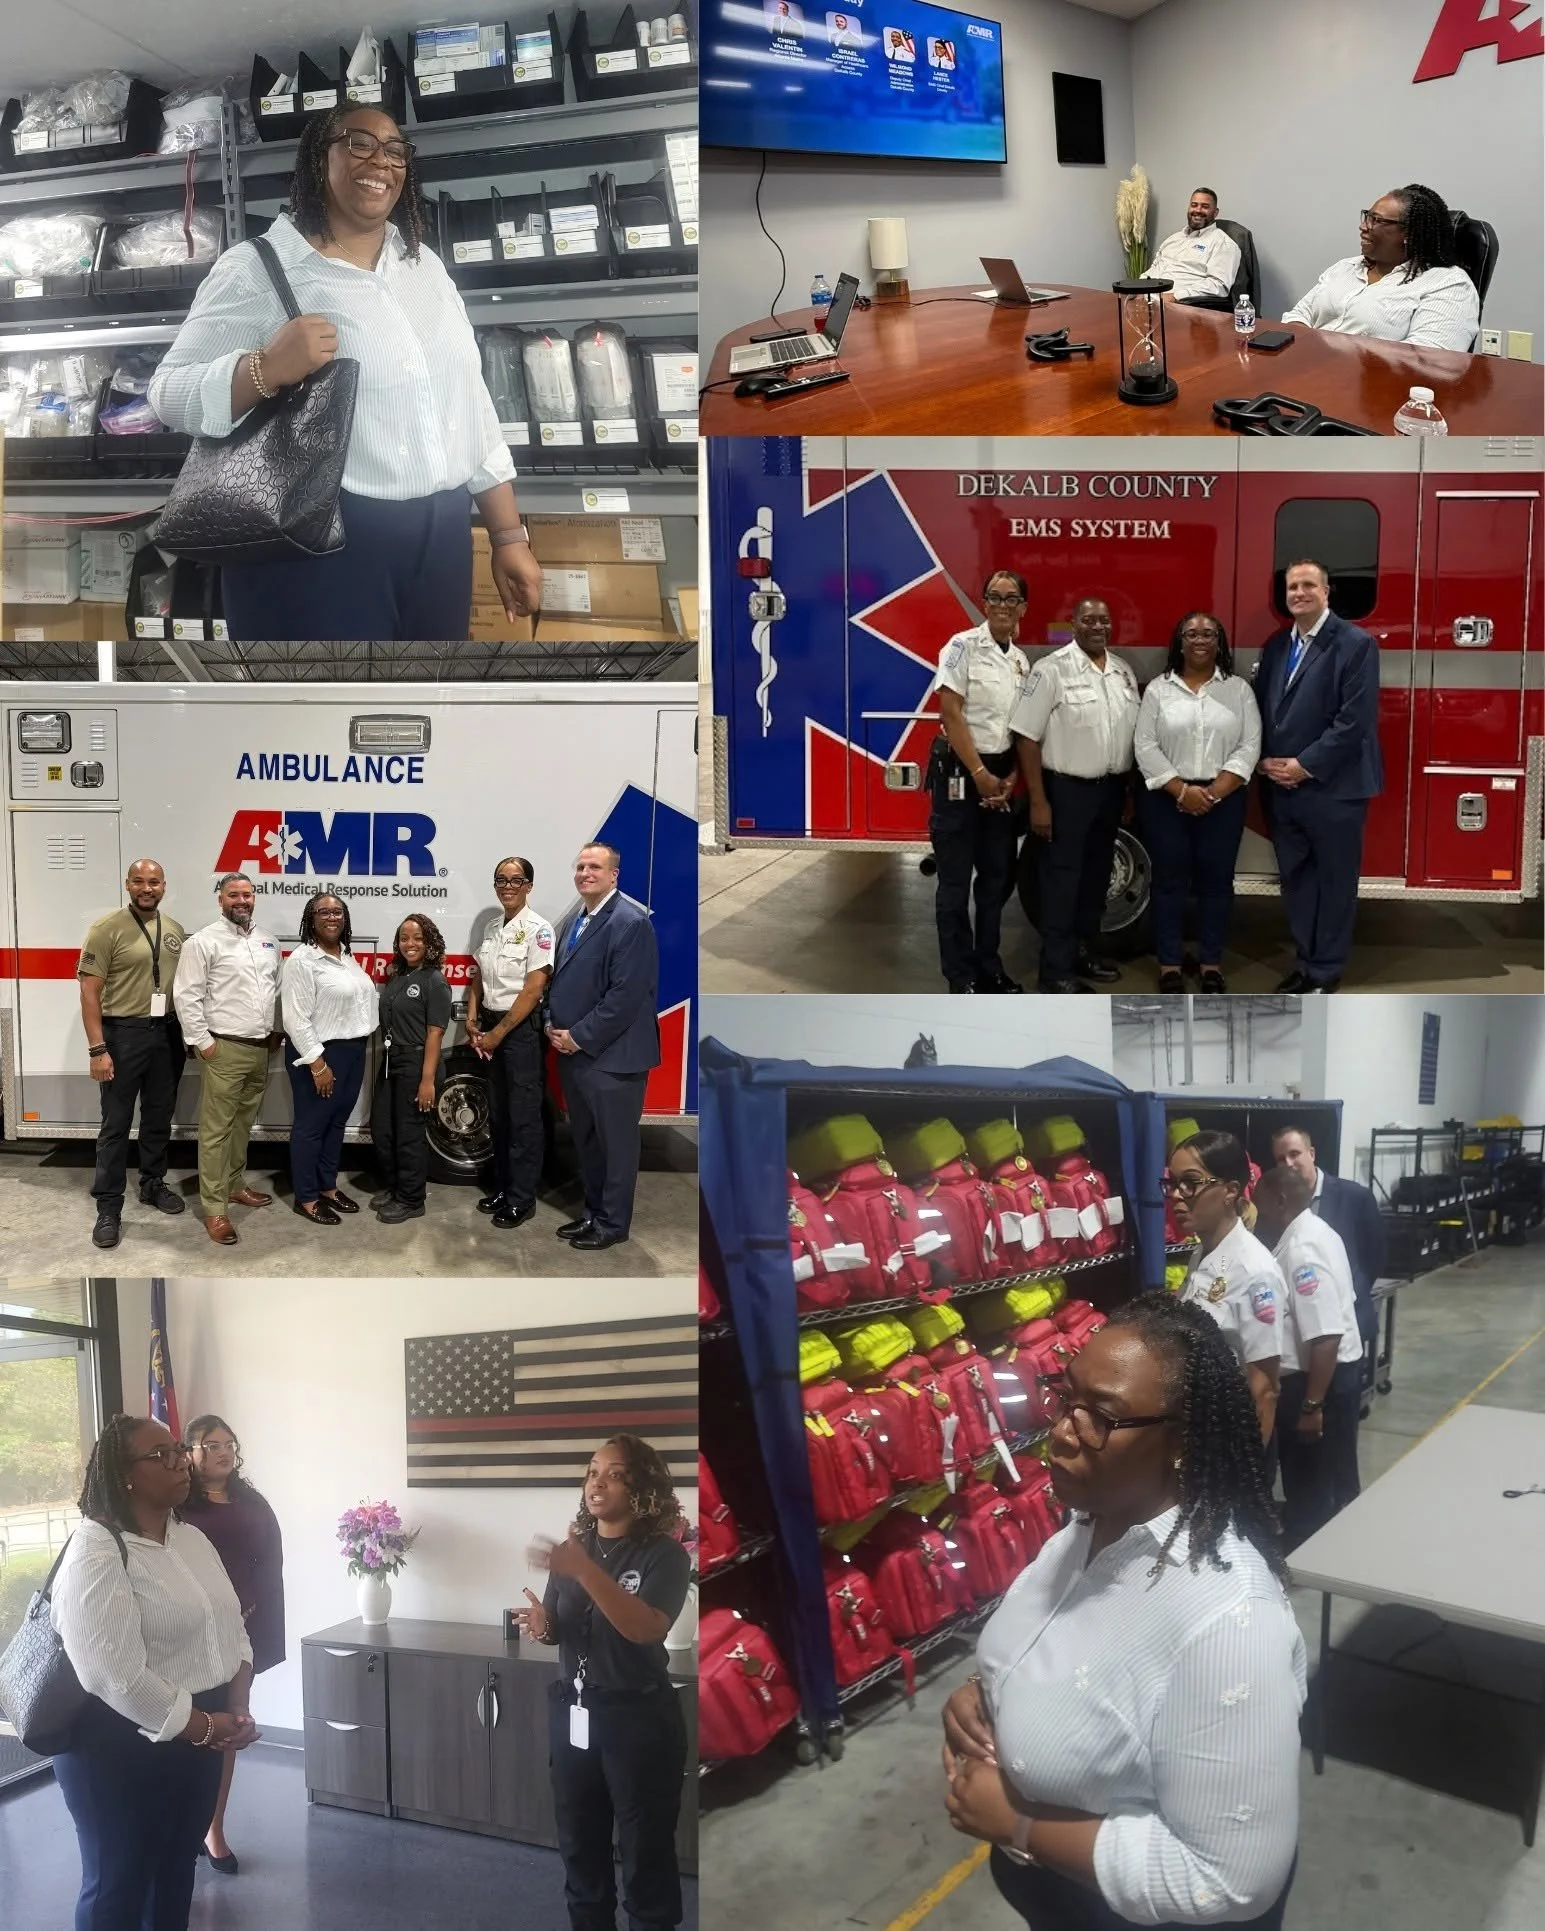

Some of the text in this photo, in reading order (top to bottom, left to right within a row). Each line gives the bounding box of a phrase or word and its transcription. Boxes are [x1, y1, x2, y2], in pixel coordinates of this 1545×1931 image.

[957, 474, 1218, 498] DEKALB COUNTY
[1008, 518, 1171, 538] EMS SYSTEM
[236, 752, 424, 784] AMBULANCE
[213, 809, 437, 876] AMR
[272, 881, 323, 895] Medical
[326, 883, 388, 899] Response
[392, 883, 448, 898] Solution
